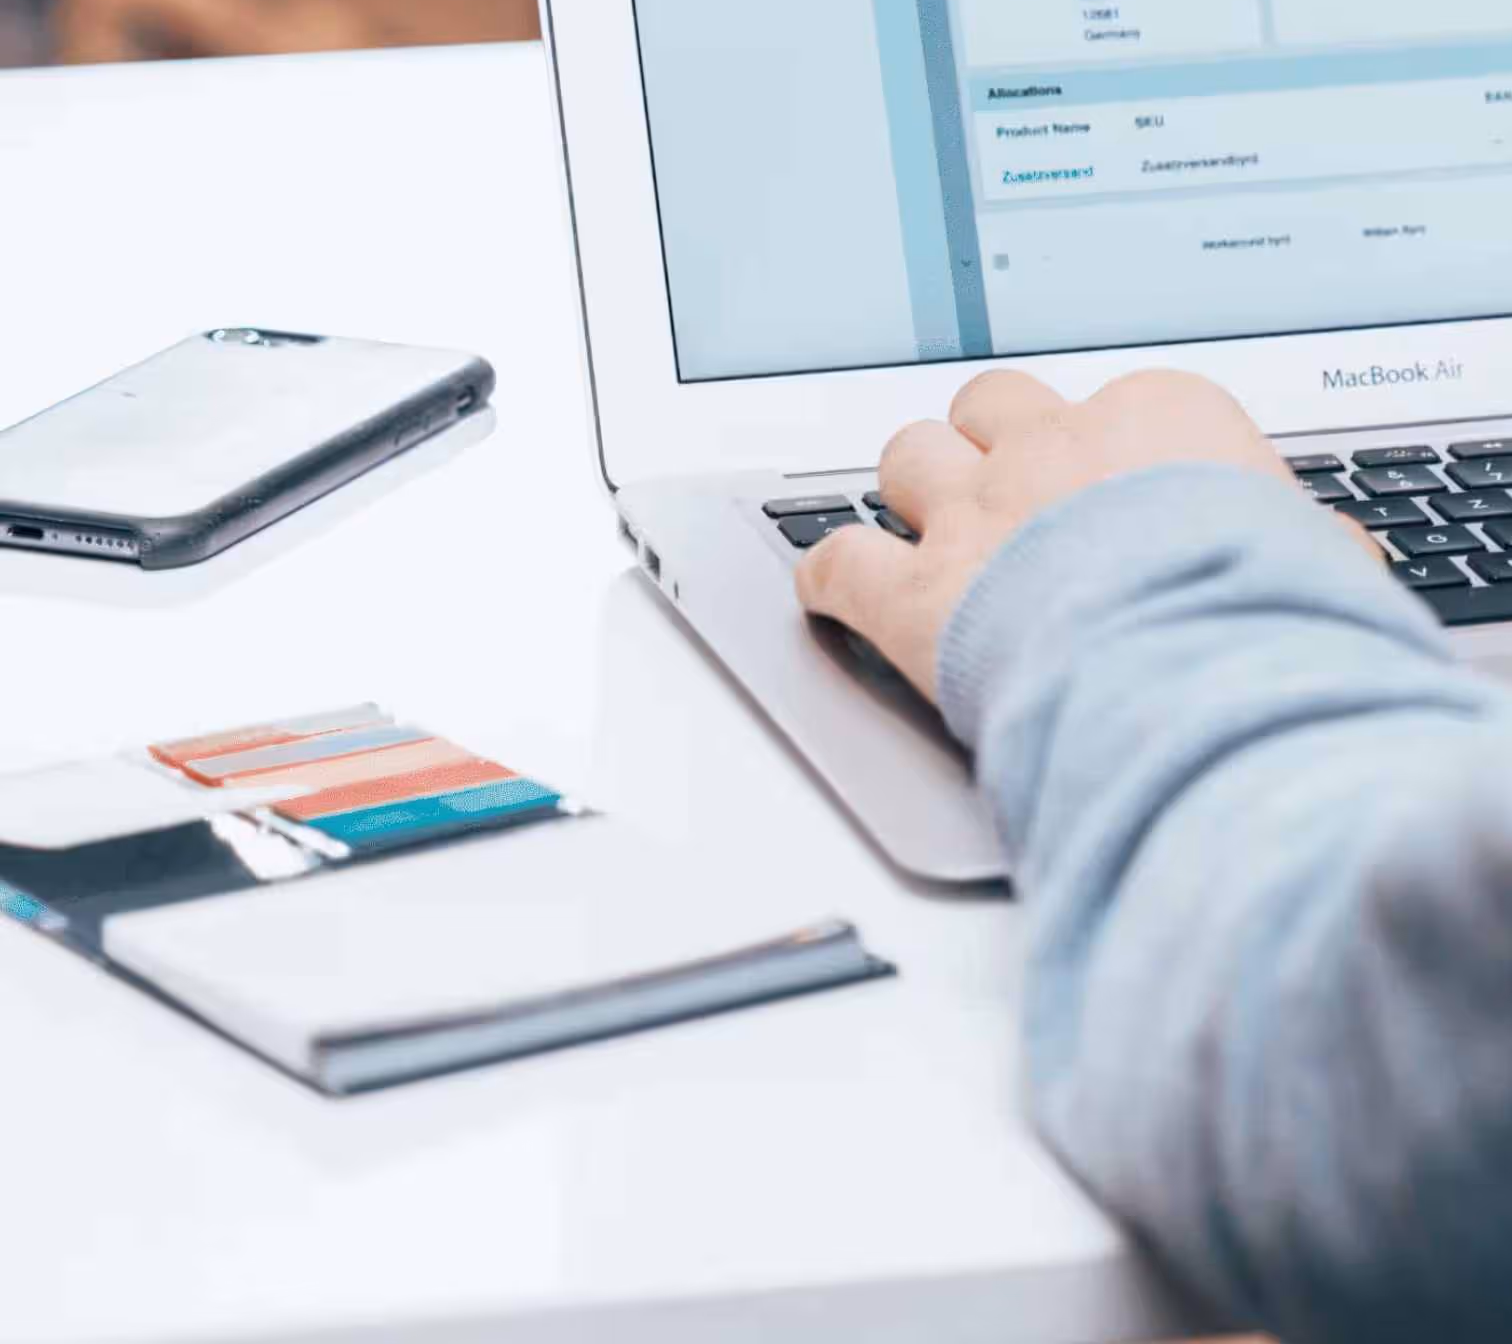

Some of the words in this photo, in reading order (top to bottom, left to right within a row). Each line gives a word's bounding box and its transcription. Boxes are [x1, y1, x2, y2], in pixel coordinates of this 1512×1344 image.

[987, 85, 1062, 100] Allocations
[1134, 115, 1165, 129] SKU
[996, 123, 1049, 139] Product
[1052, 121, 1091, 135] Name
[1321, 363, 1430, 390] MacBook
[1434, 358, 1464, 379] Air
[1467, 498, 1489, 510] Z
[1426, 532, 1449, 544] G
[1409, 566, 1429, 578] V
